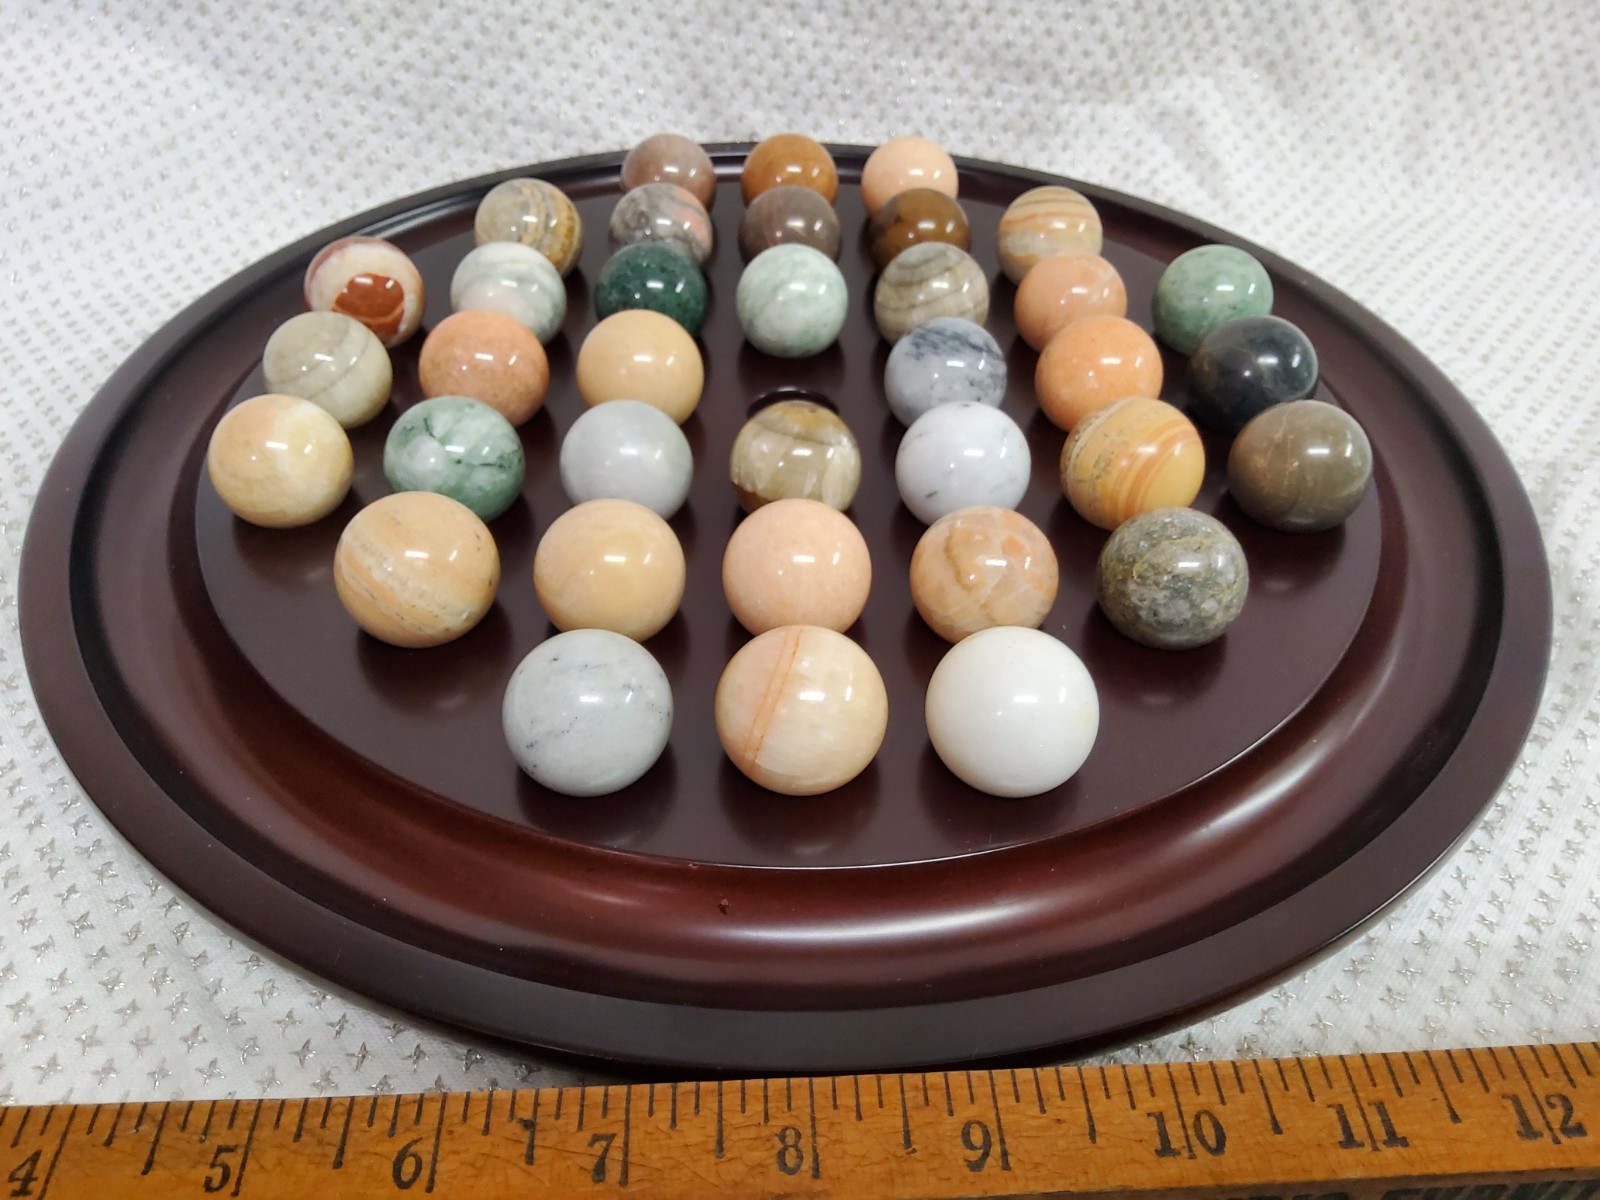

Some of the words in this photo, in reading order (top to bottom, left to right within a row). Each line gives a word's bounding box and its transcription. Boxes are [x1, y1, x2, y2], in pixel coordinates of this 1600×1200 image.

[8, 1149, 43, 1197] 4
[203, 1144, 238, 1193] 5
[392, 1137, 423, 1190] 6
[587, 1133, 617, 1183] 7
[775, 1126, 804, 1175] 8
[960, 1119, 992, 1173] 9
[1146, 1109, 1227, 1158] 10
[1326, 1101, 1409, 1149] 11
[1502, 1093, 1588, 1141] 12
